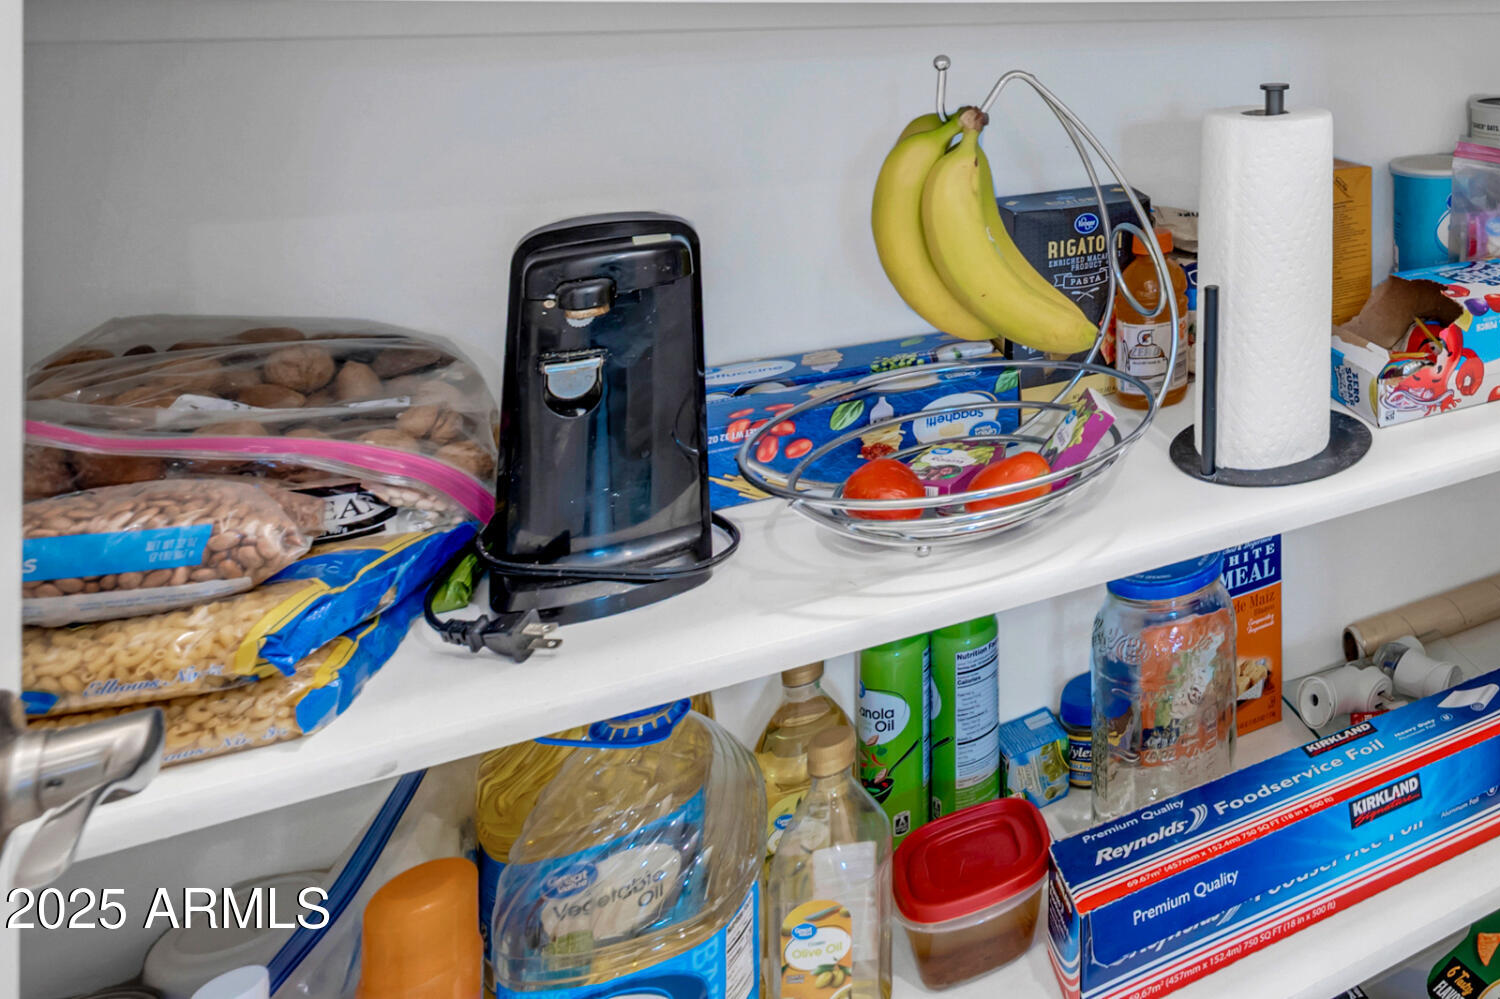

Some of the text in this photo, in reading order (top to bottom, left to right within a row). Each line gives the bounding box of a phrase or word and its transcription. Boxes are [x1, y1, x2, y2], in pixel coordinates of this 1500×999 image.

[1049, 256, 1085, 268] ENRICHED
[1071, 260, 1102, 271] PRODUCT
[1070, 274, 1102, 286] PASTA
[925, 407, 984, 428] Spaghetti
[957, 675, 981, 686] Calories
[875, 720, 895, 733] Oil
[1305, 722, 1372, 753] KIRKLAND
[1213, 737, 1386, 816] Foodservice Foil
[1352, 777, 1419, 817] KIRKLAND
[1441, 796, 1480, 819] Aluminum Foil
[1354, 792, 1421, 827] Signature
[1082, 800, 1184, 844] Premium Quality
[1095, 820, 1185, 867] Reynolds
[637, 884, 663, 907] Oil
[1133, 870, 1239, 926] Premium Quality
[791, 941, 843, 959] Olive Oil
